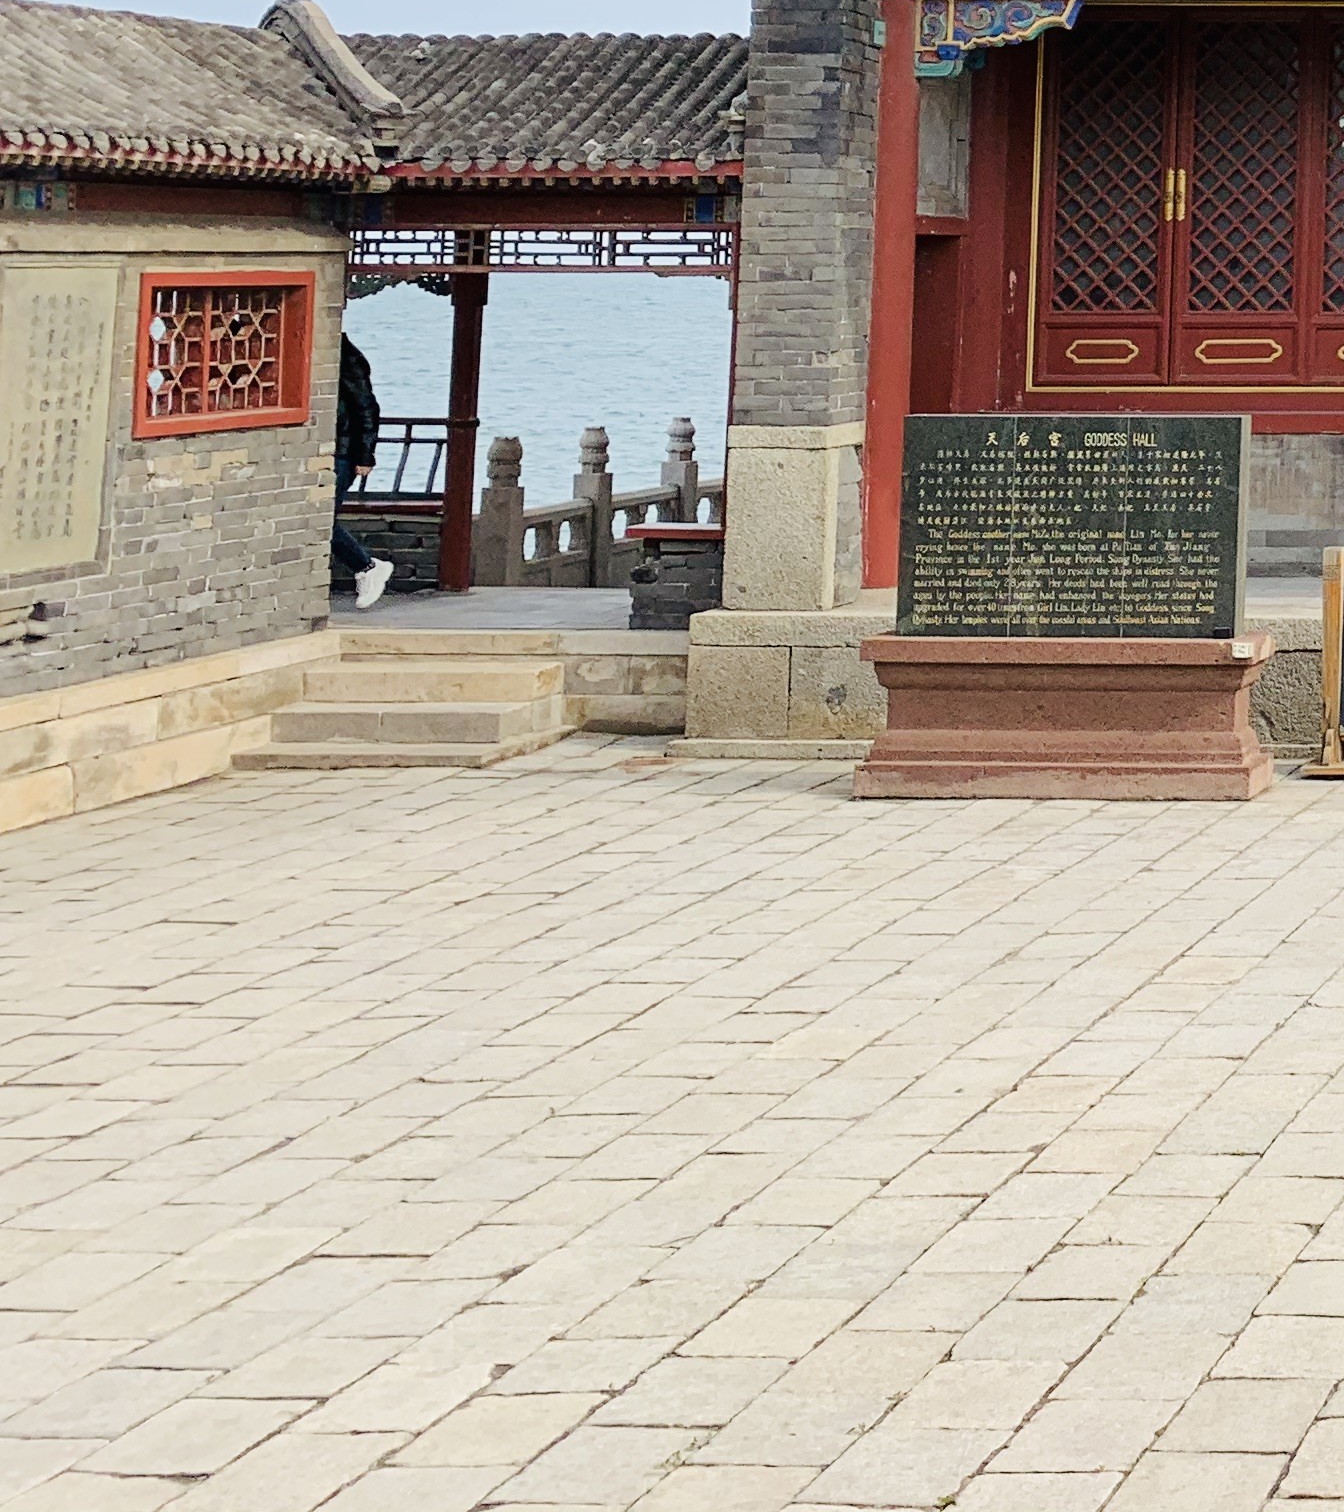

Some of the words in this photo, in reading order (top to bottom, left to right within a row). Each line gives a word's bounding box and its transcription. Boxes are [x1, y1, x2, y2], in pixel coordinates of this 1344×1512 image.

[986, 431, 1062, 447] 天后宫
[1084, 432, 1127, 447] GODDESS
[1132, 432, 1158, 447] HALL
[1068, 530, 1102, 541] original
[915, 544, 943, 553] crying
[1078, 542, 1096, 551] born
[1188, 555, 1202, 563] had
[914, 566, 941, 576] ability
[914, 579, 945, 587] married
[1132, 579, 1147, 587] well
[1039, 591, 1055, 599] had
